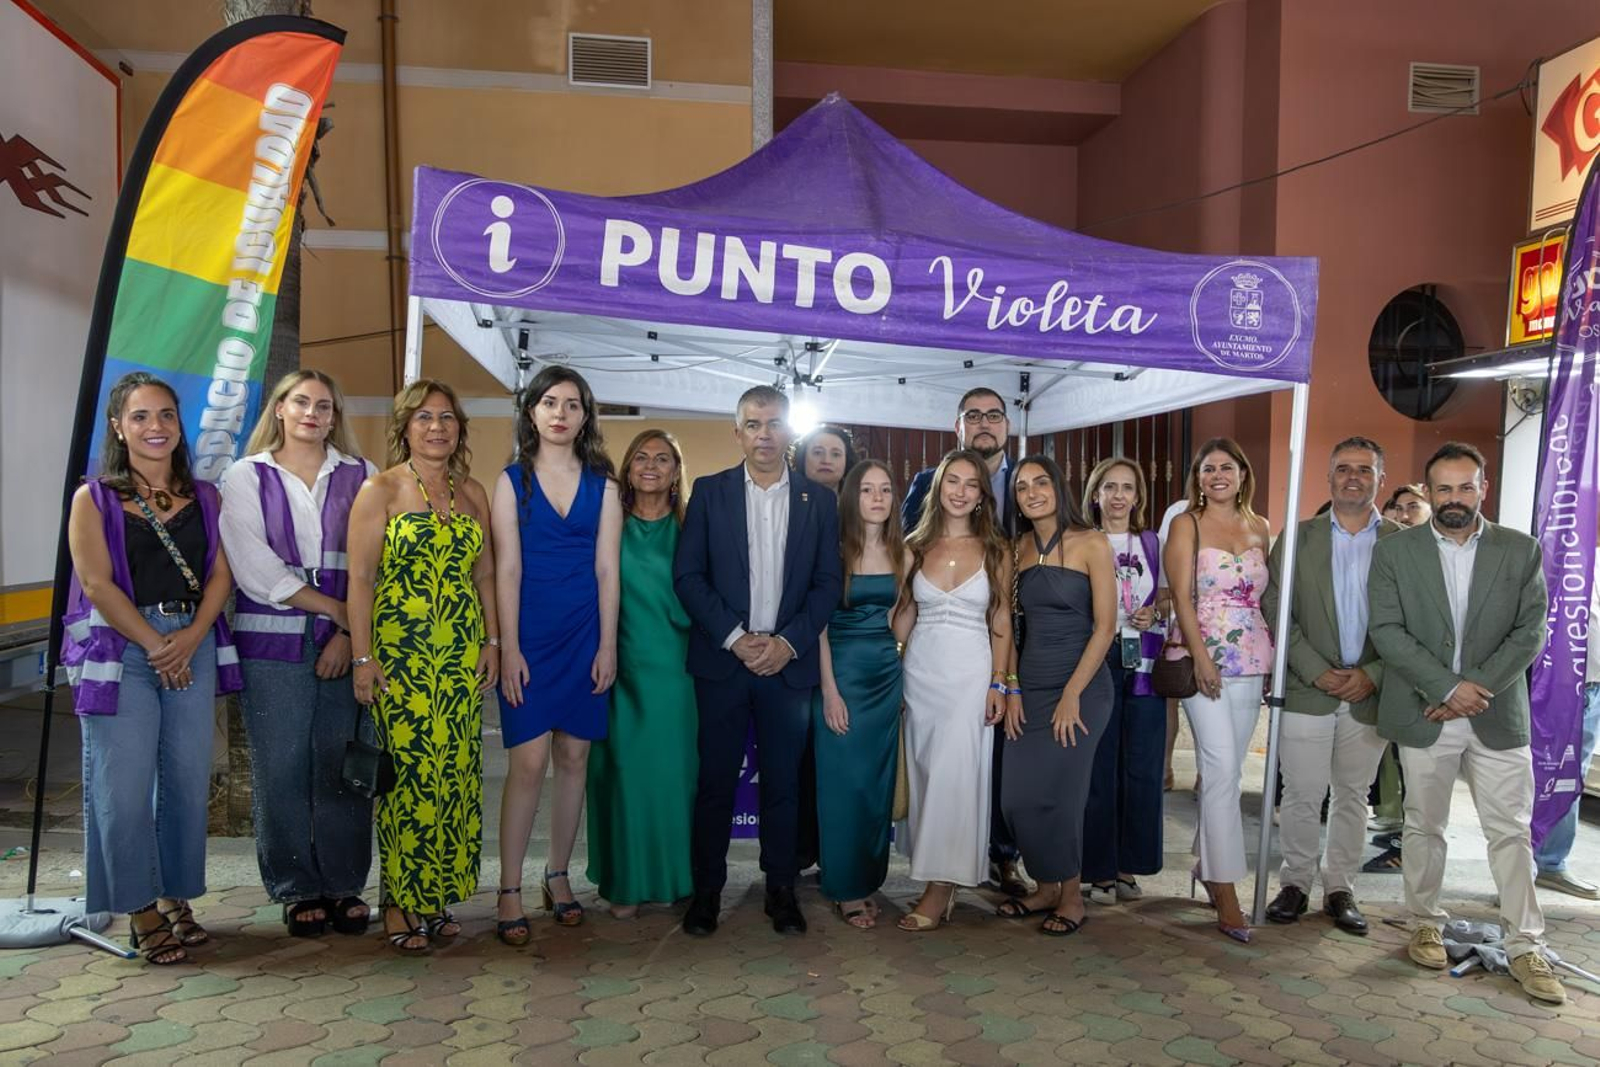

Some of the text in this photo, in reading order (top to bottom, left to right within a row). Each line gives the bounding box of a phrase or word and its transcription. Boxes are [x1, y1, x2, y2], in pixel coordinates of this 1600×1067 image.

[194, 83, 313, 482] SPACIO DE IGUALDAD
[600, 219, 1158, 335] PUNTO Violeta
[1213, 341, 1272, 352] AYUNTAMIENTO
[1232, 350, 1264, 359] MARTOS
[731, 812, 759, 825] sio
